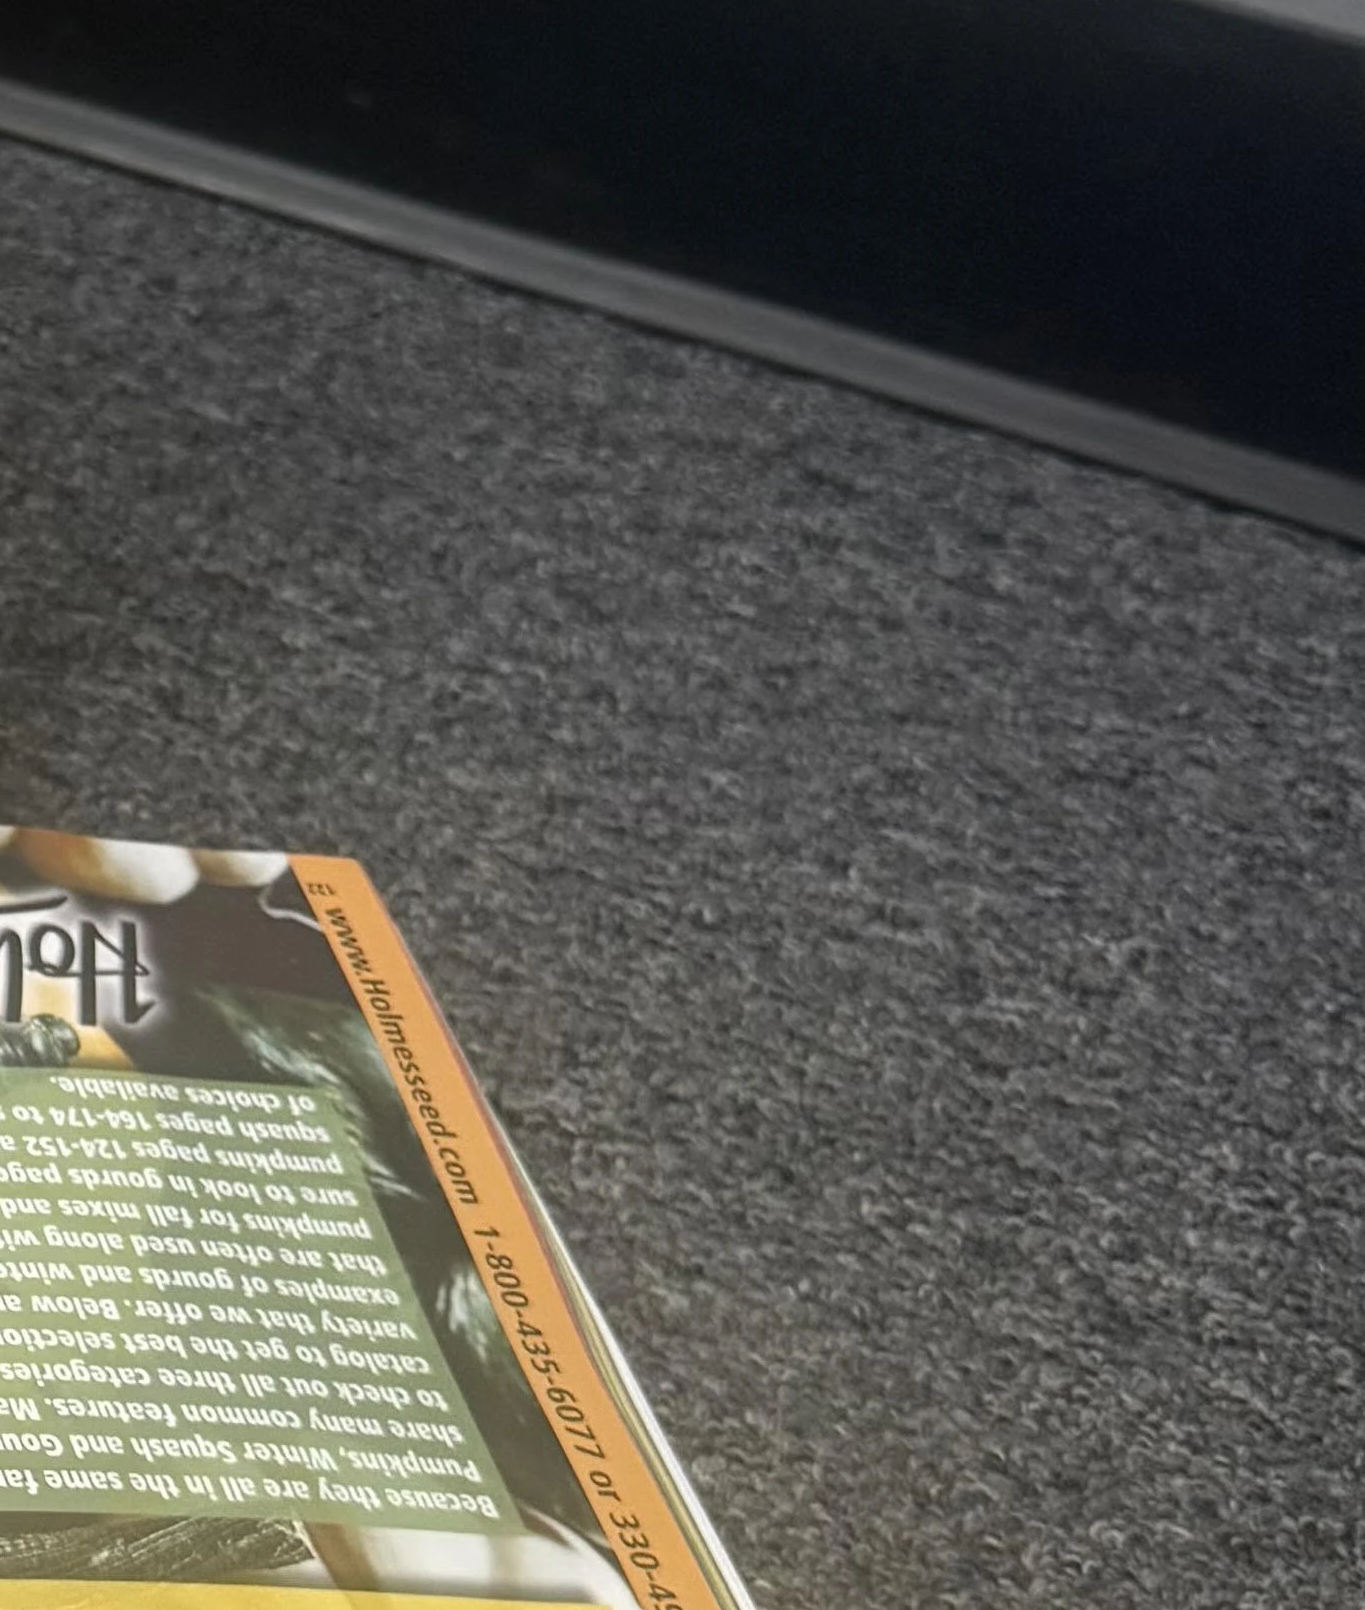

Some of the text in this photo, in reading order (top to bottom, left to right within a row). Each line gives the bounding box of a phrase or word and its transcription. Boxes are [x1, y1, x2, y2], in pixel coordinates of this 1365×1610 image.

[323, 907, 475, 1205] www.Holmesseed.com
[473, 1225, 605, 1463] 1-800-435-6077
[589, 1471, 619, 1501] or
[69, 1435, 124, 1459] and
[130, 1434, 238, 1463] Squash
[244, 1442, 338, 1471] Winter
[339, 1447, 483, 1483] Pumpkins,
[43, 1470, 123, 1490] same
[129, 1473, 179, 1500] the
[184, 1475, 217, 1501] in
[219, 1477, 256, 1502] all
[263, 1478, 310, 1499] are
[319, 1477, 381, 1511] they
[385, 1489, 499, 1519] Because
